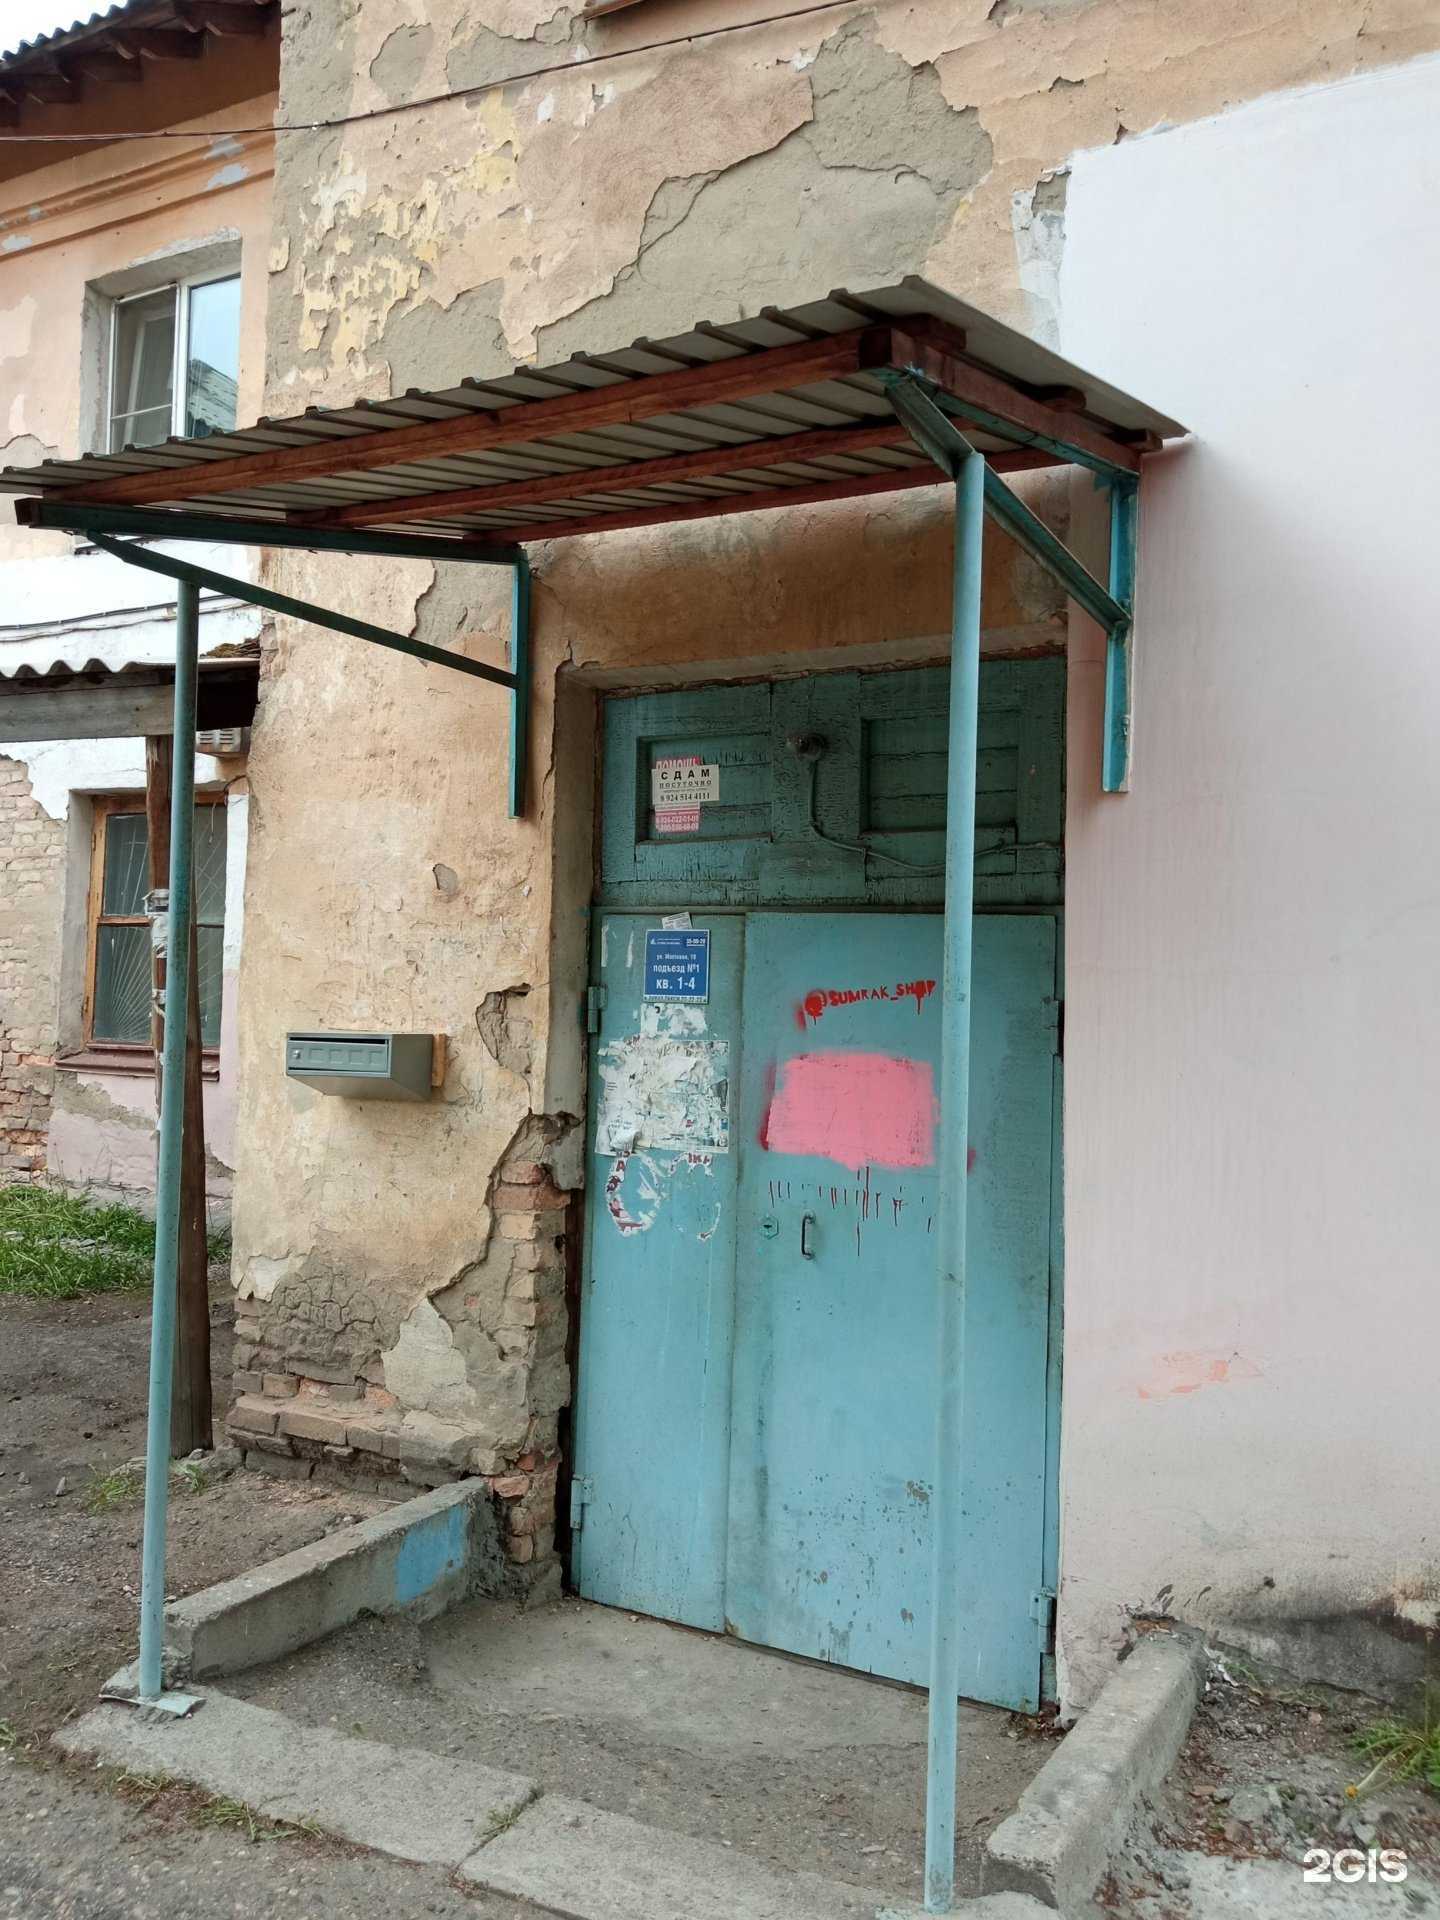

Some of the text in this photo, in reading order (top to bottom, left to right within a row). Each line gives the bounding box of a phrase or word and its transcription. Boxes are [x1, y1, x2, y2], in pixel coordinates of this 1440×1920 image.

[661, 769, 710, 780] СДАМ
[653, 964, 700, 973] подъезд №1
[656, 976, 696, 990] кв. 1-4
